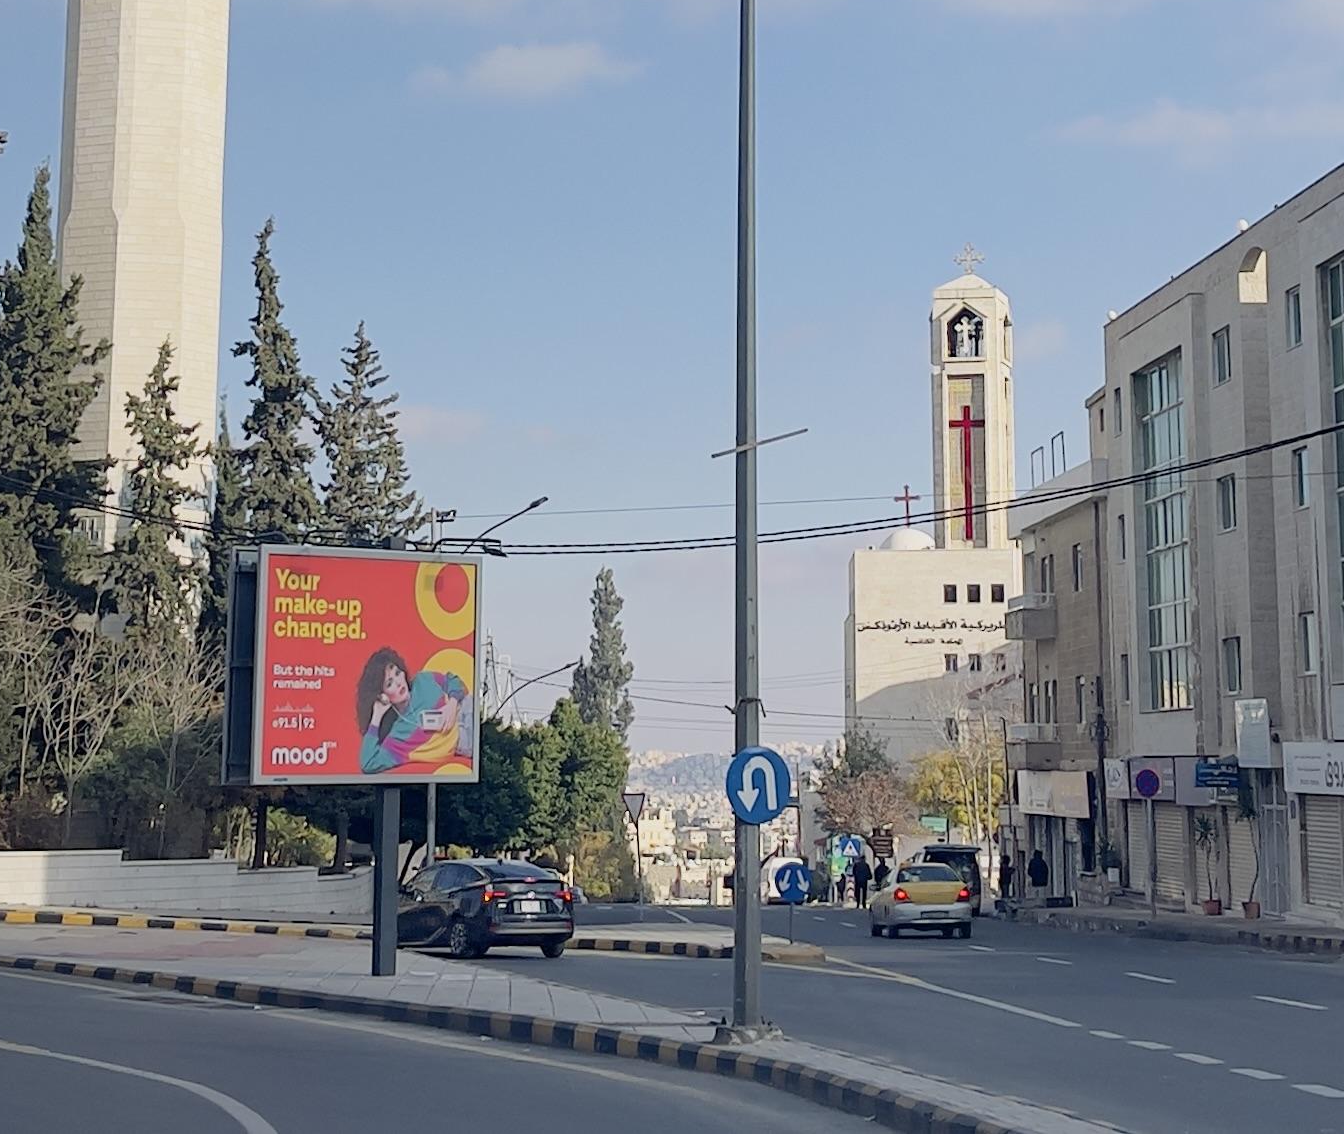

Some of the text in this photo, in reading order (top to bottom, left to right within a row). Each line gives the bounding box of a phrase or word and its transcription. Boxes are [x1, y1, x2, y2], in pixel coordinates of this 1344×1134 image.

[275, 568, 321, 591] Your
[274, 592, 362, 622] make-up
[273, 615, 367, 644] changed.
[960, 618, 1005, 633] طريركية
[273, 665, 335, 678] But the hits
[273, 679, 322, 690] remained
[271, 742, 328, 765] mood
